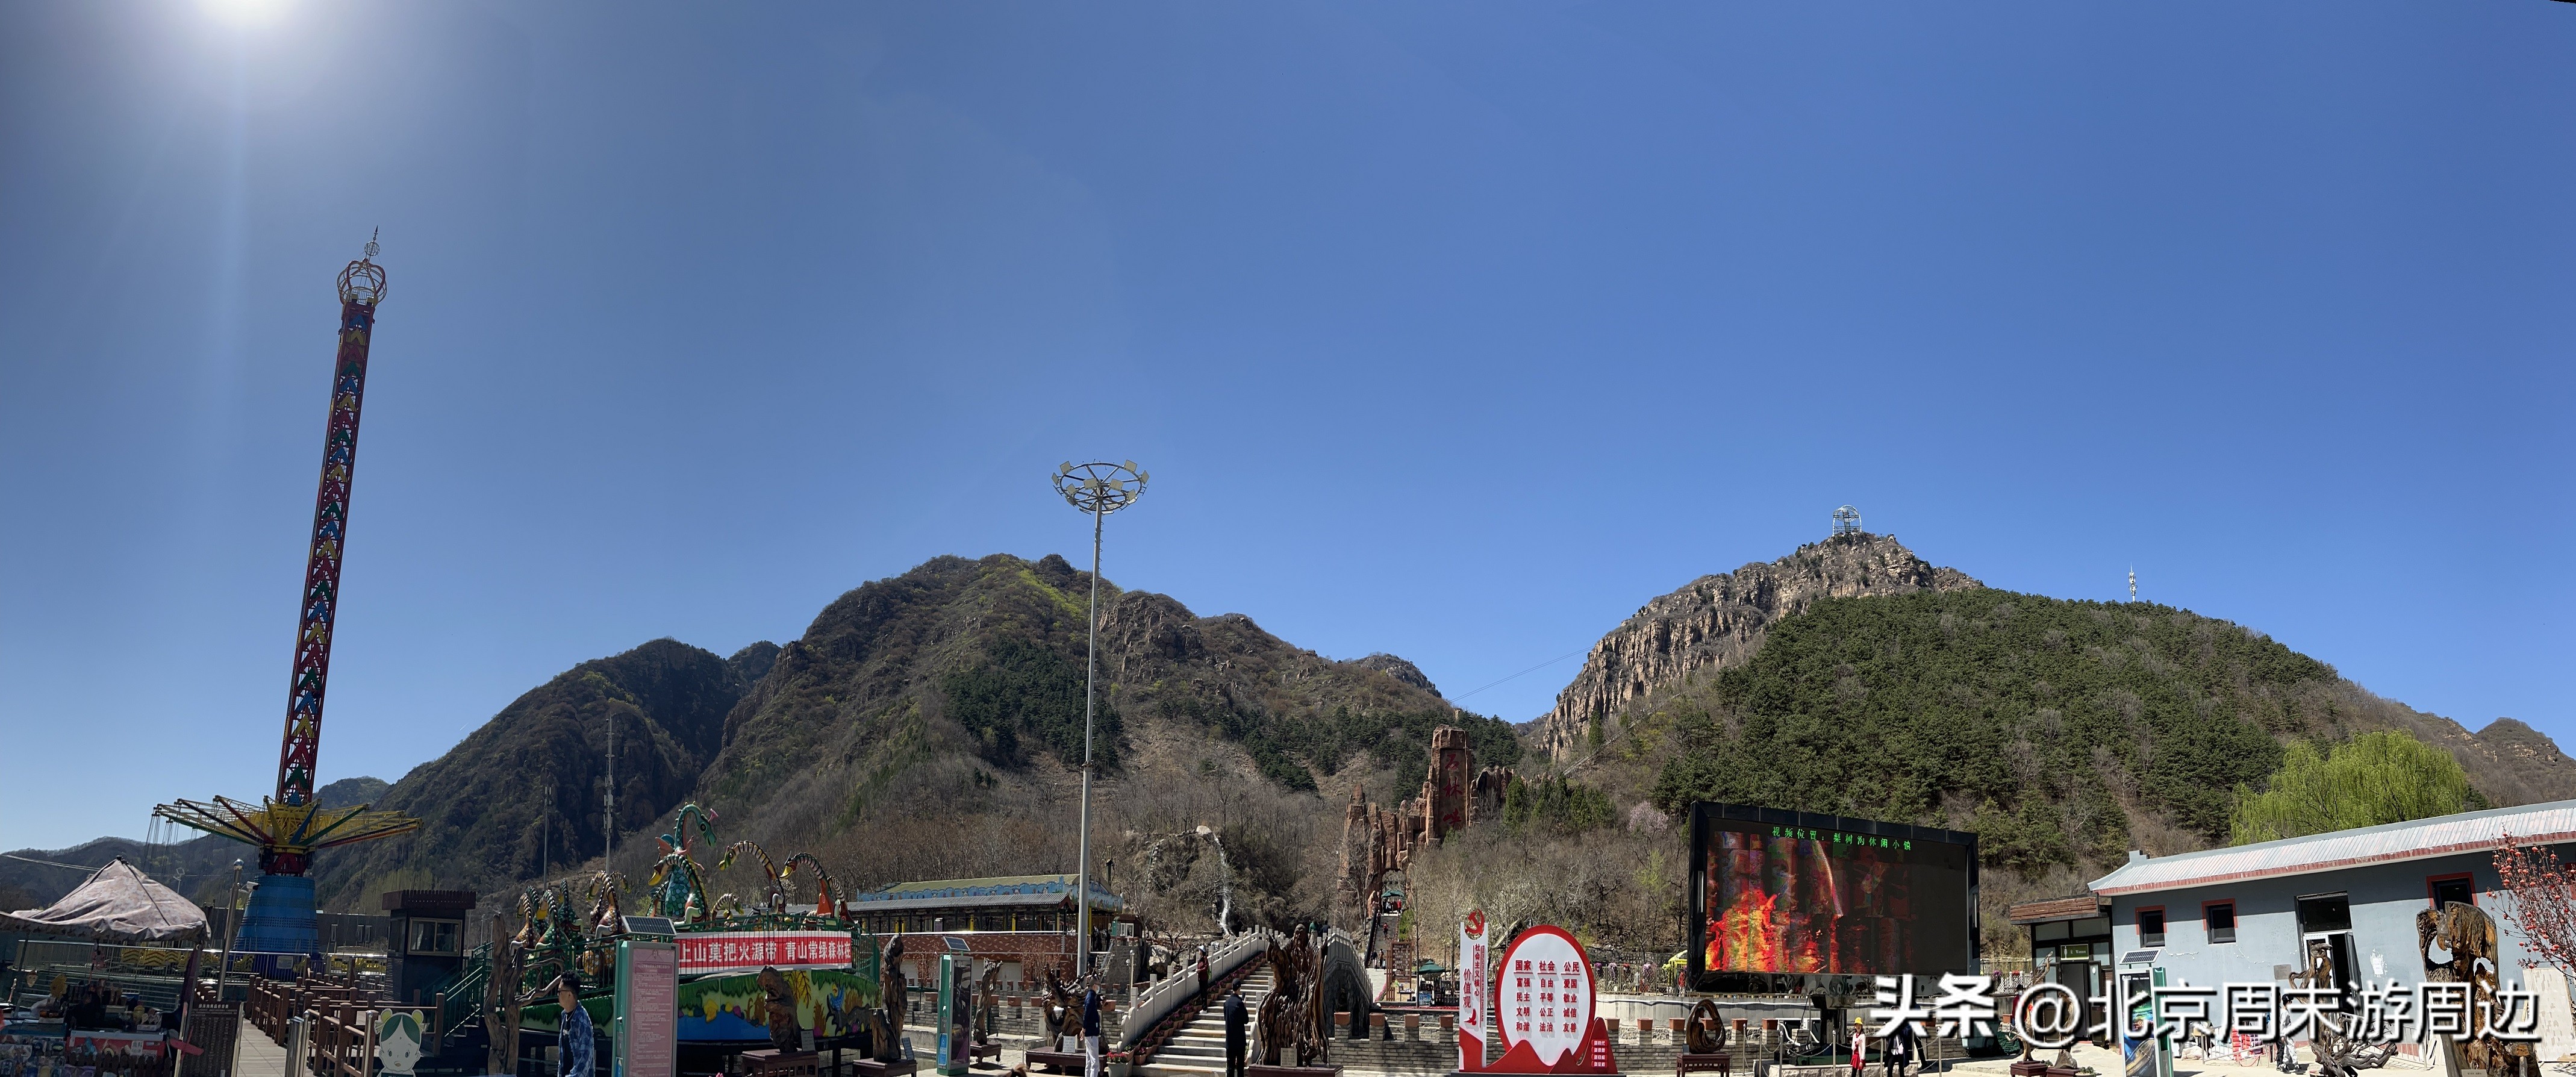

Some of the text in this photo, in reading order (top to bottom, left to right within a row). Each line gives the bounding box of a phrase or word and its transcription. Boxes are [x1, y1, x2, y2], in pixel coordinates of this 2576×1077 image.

[1443, 754, 1463, 830] 石林峡
[679, 941, 851, 963] 上山莫把火源带 青山常绿森林在
[1515, 960, 1579, 972] 国家 社会 公民
[1463, 968, 1472, 1008] 价值观
[1516, 977, 1577, 988] 富强 自由 爱国
[1516, 992, 1577, 1003] 民主 平等 敬业
[1516, 1007, 1577, 1017] 文明 公正 诚信
[1516, 1022, 1577, 1032] 和谐 法治 友善
